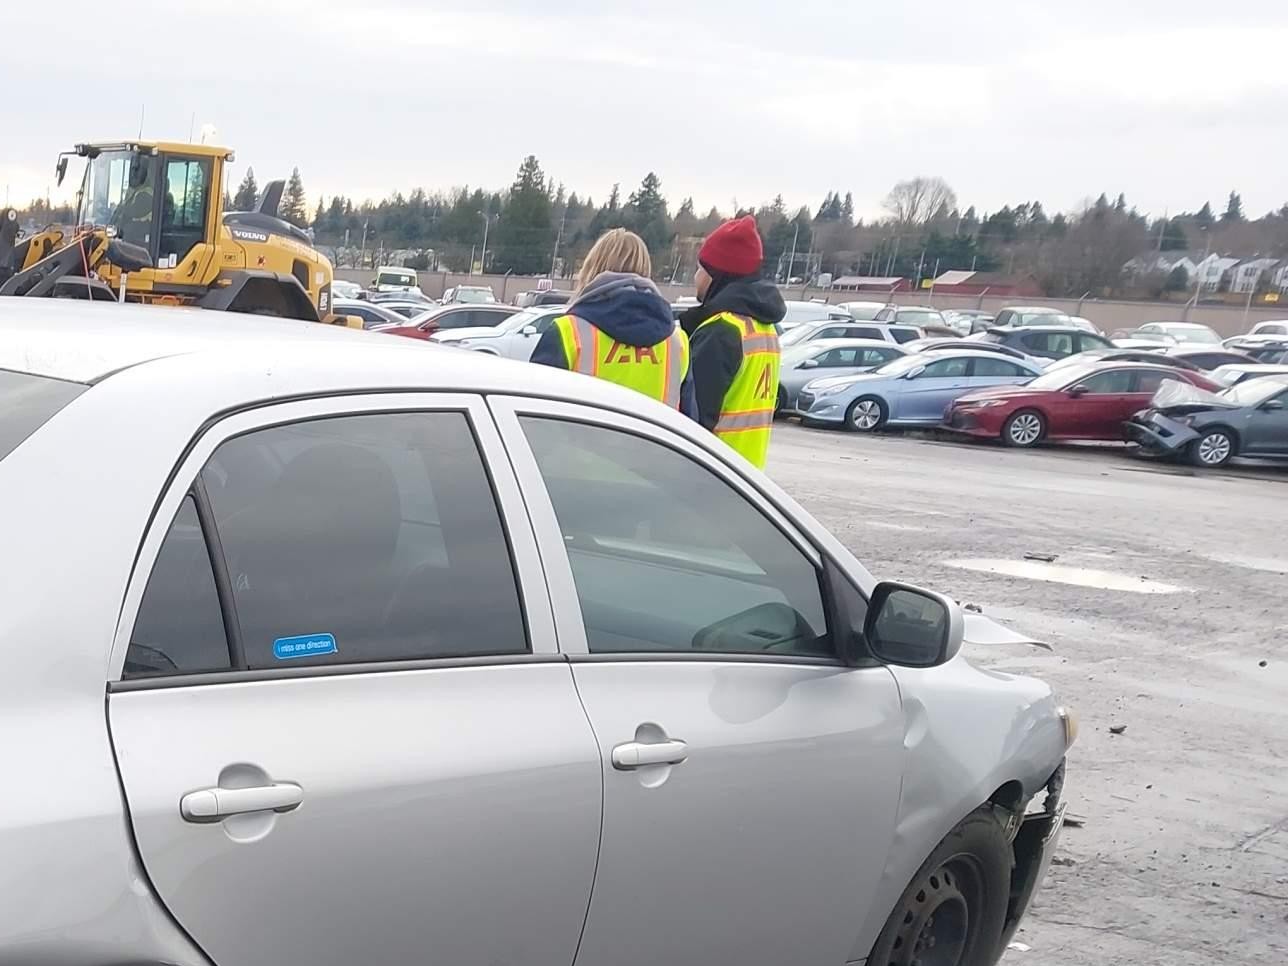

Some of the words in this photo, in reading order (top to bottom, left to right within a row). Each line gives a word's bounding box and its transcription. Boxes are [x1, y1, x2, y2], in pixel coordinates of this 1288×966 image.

[233, 230, 267, 241] VOLVO
[281, 644, 295, 653] miss
[295, 643, 306, 651] one
[306, 640, 331, 650] direction
